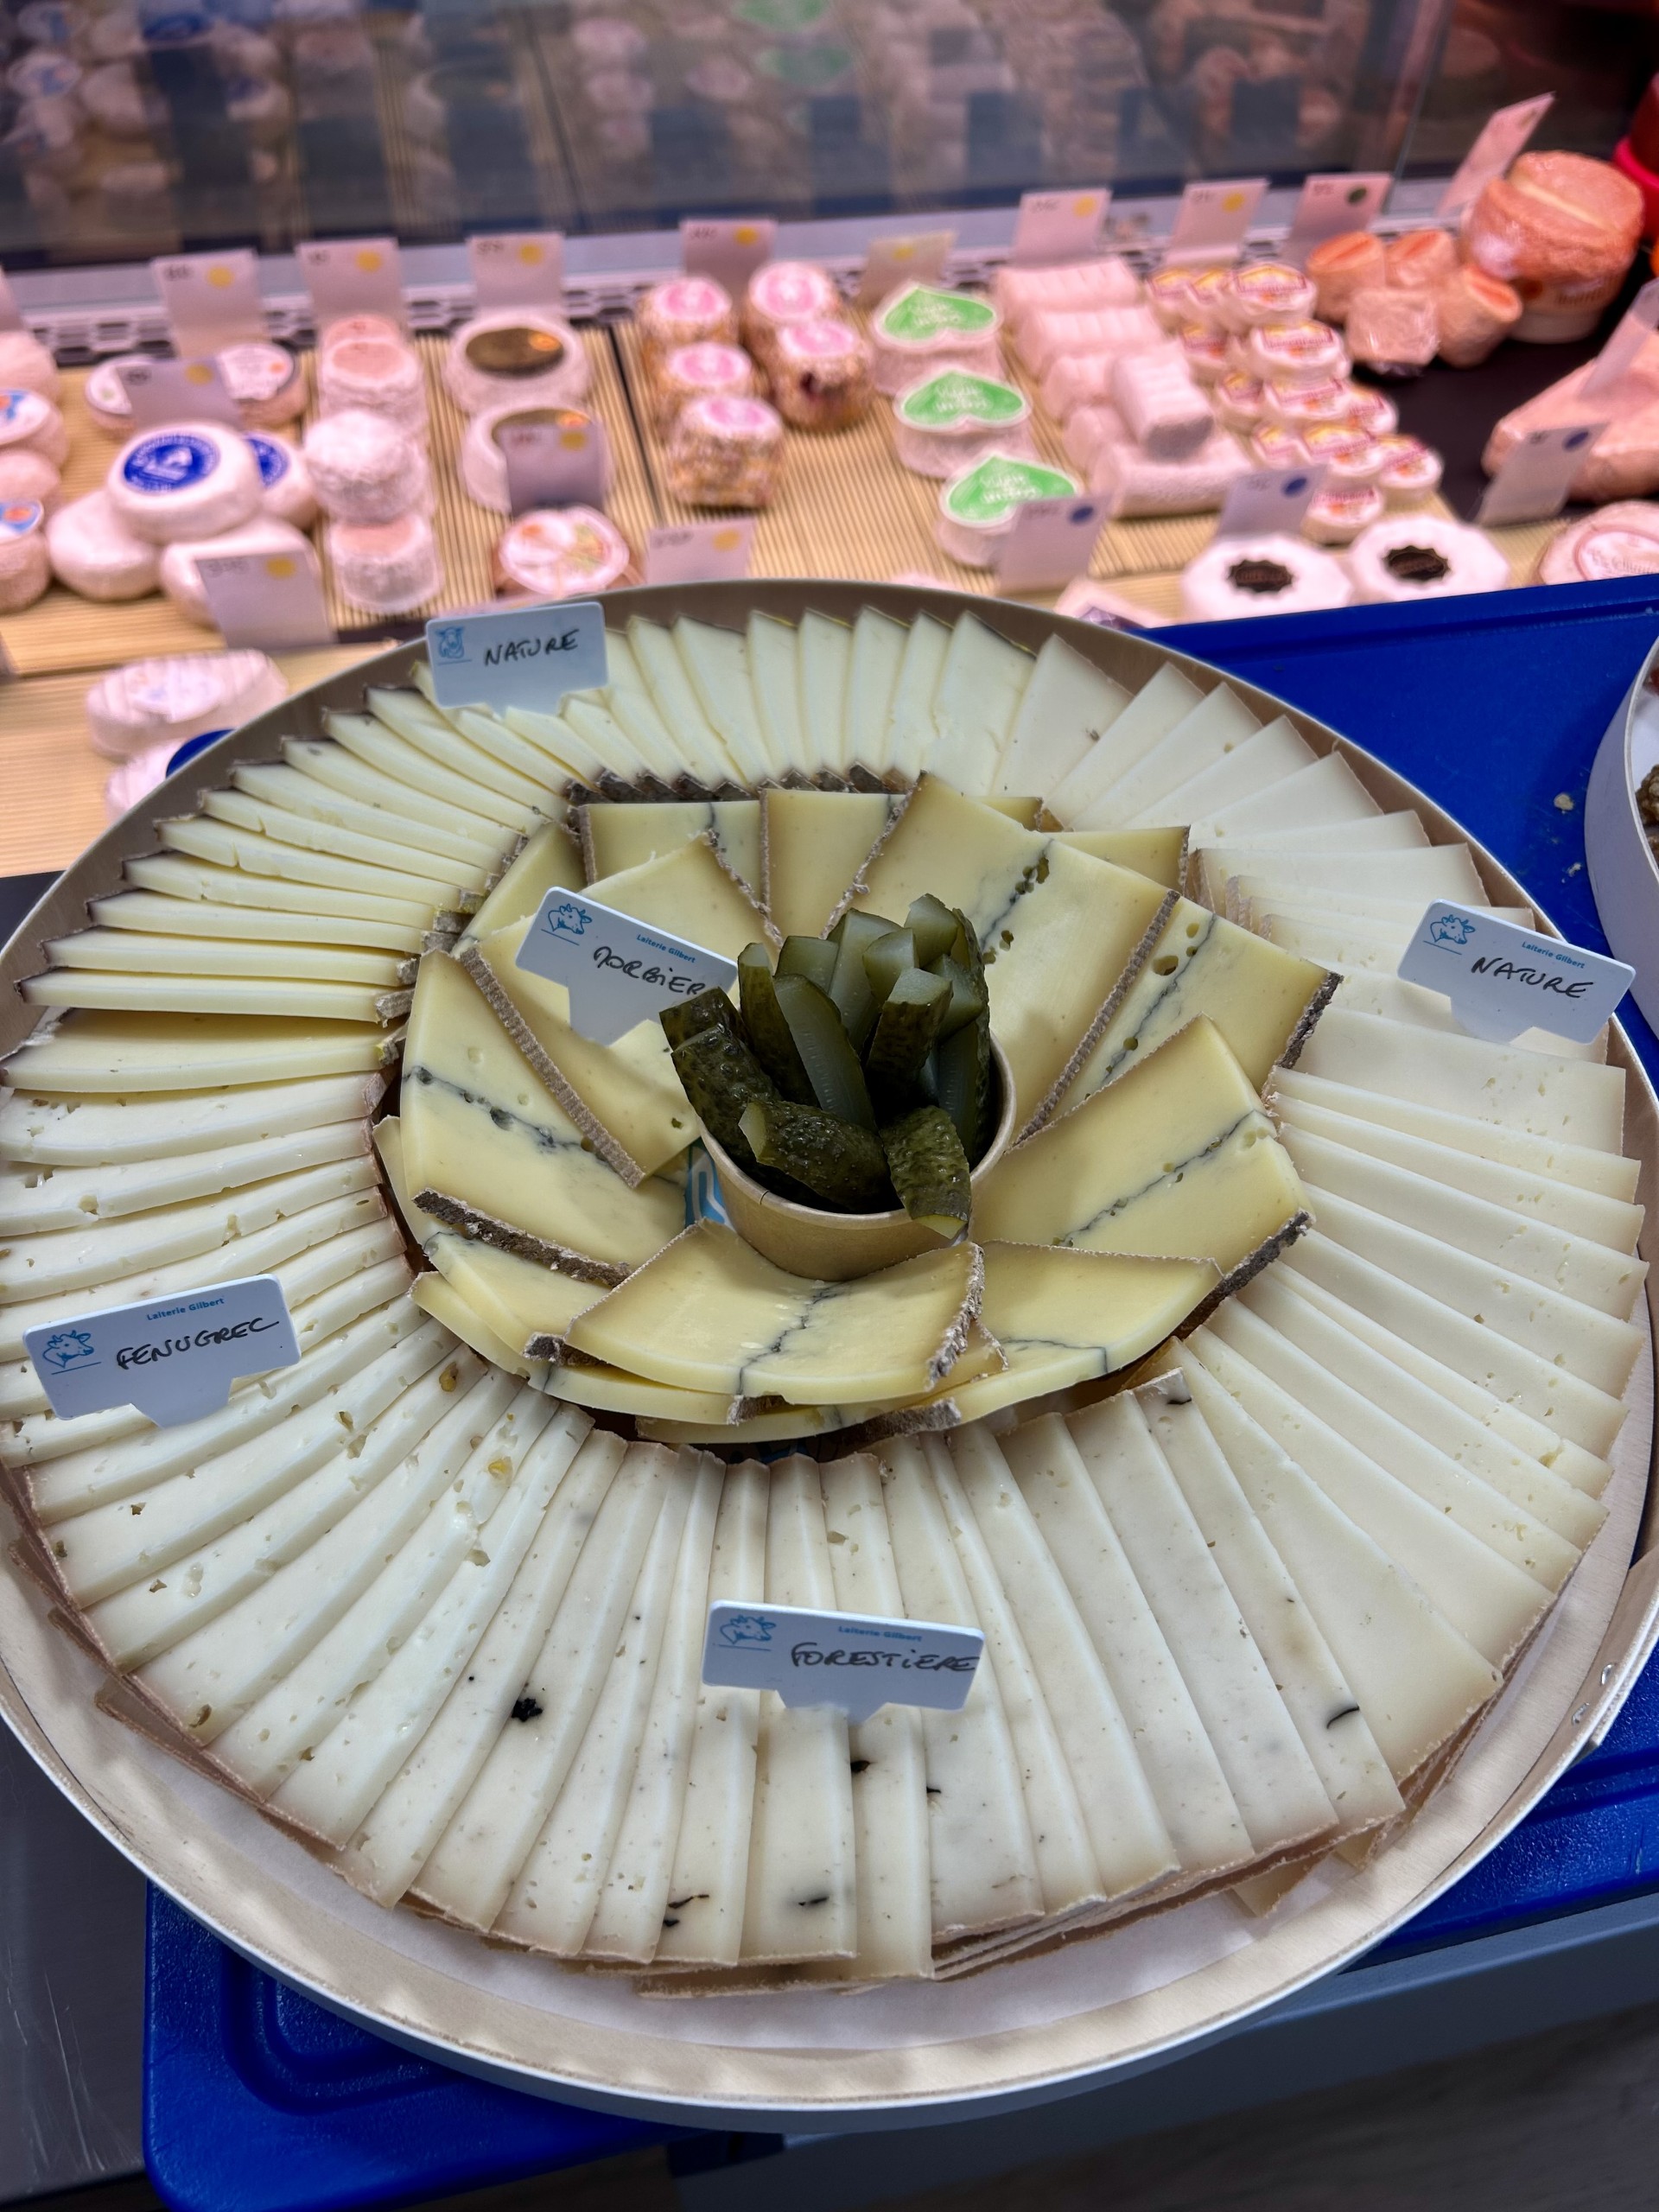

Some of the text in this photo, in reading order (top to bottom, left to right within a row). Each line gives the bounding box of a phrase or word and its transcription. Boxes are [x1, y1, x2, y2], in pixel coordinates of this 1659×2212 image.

[484, 628, 580, 666] NATURE
[636, 933, 696, 963] Laiterie Gilbert
[1522, 941, 1586, 969] Laiterie Gilbert
[1471, 957, 1593, 999] NATURE
[147, 1297, 225, 1321] Laiterie Gilbert
[116, 1317, 280, 1370] FENUGREC
[838, 1625, 922, 1642] Laiterie Gilbert
